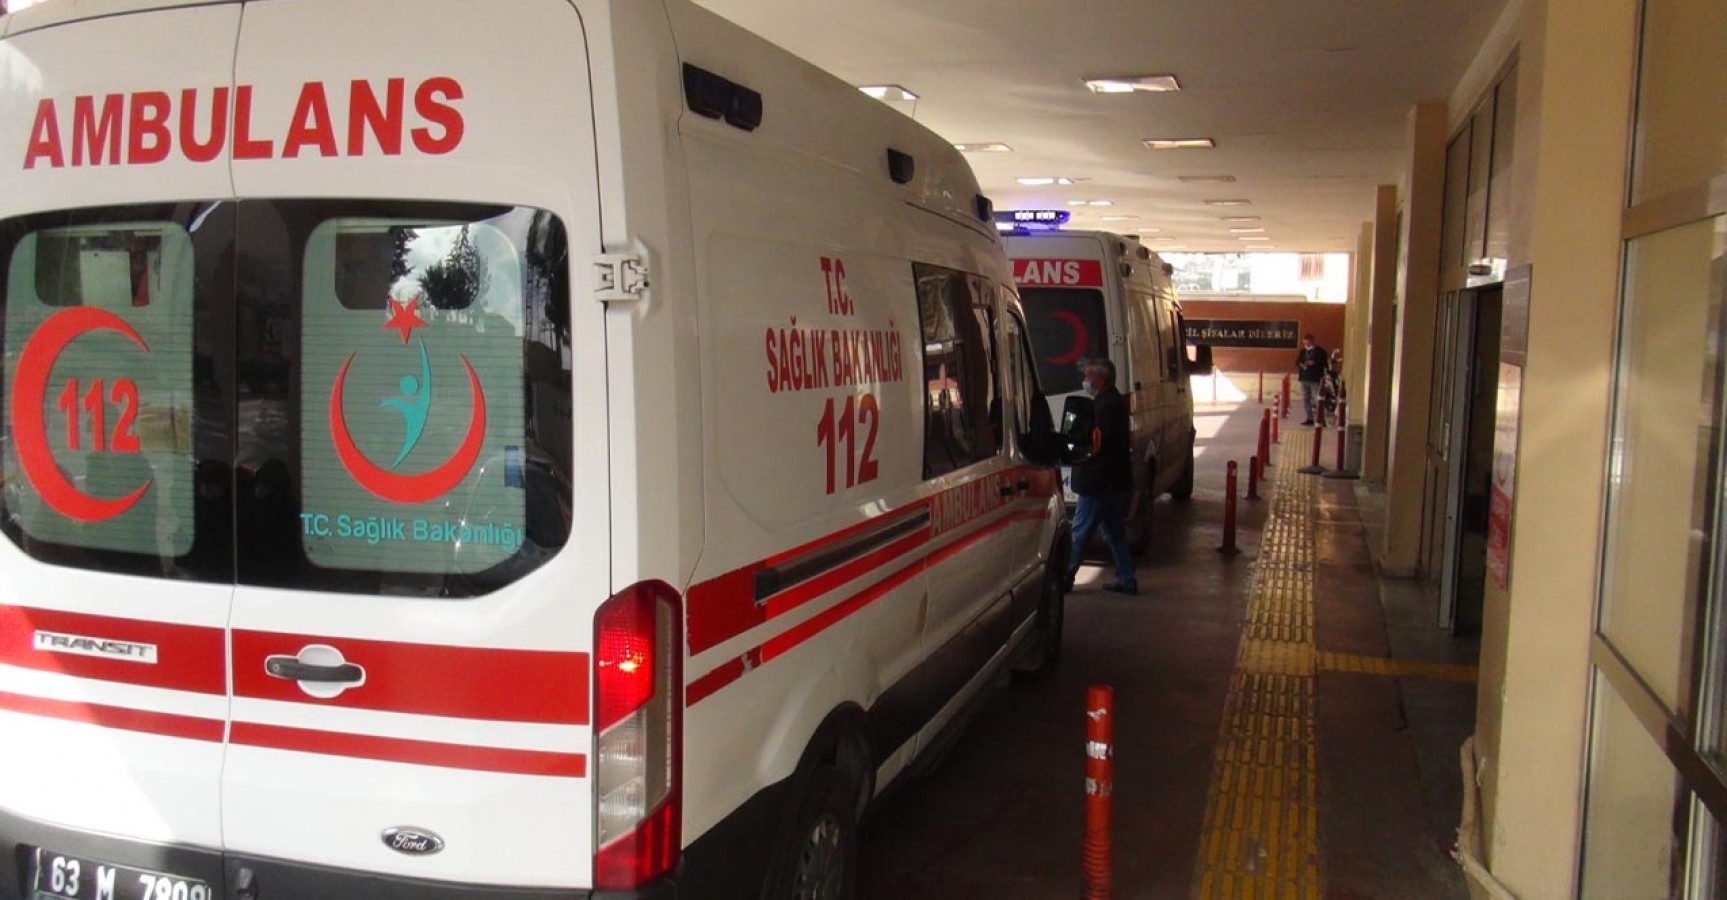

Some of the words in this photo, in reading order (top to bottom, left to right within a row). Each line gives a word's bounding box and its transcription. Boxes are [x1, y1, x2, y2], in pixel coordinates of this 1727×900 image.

[23, 76, 465, 170] AMBULANS
[820, 256, 854, 316] T.C.
[766, 315, 828, 393] SAĞLIK
[831, 317, 902, 386] BAKANLIĞI
[57, 377, 140, 453] 112
[817, 393, 879, 495] 112
[301, 513, 333, 537] T.C.
[337, 514, 405, 545] Sağlık
[412, 518, 523, 550] Bakanlığı
[931, 473, 1002, 537] AMBULANS
[36, 632, 154, 657] TRANSIT
[393, 833, 428, 851] Ford
[52, 856, 81, 896] 63
[96, 865, 116, 900] M
